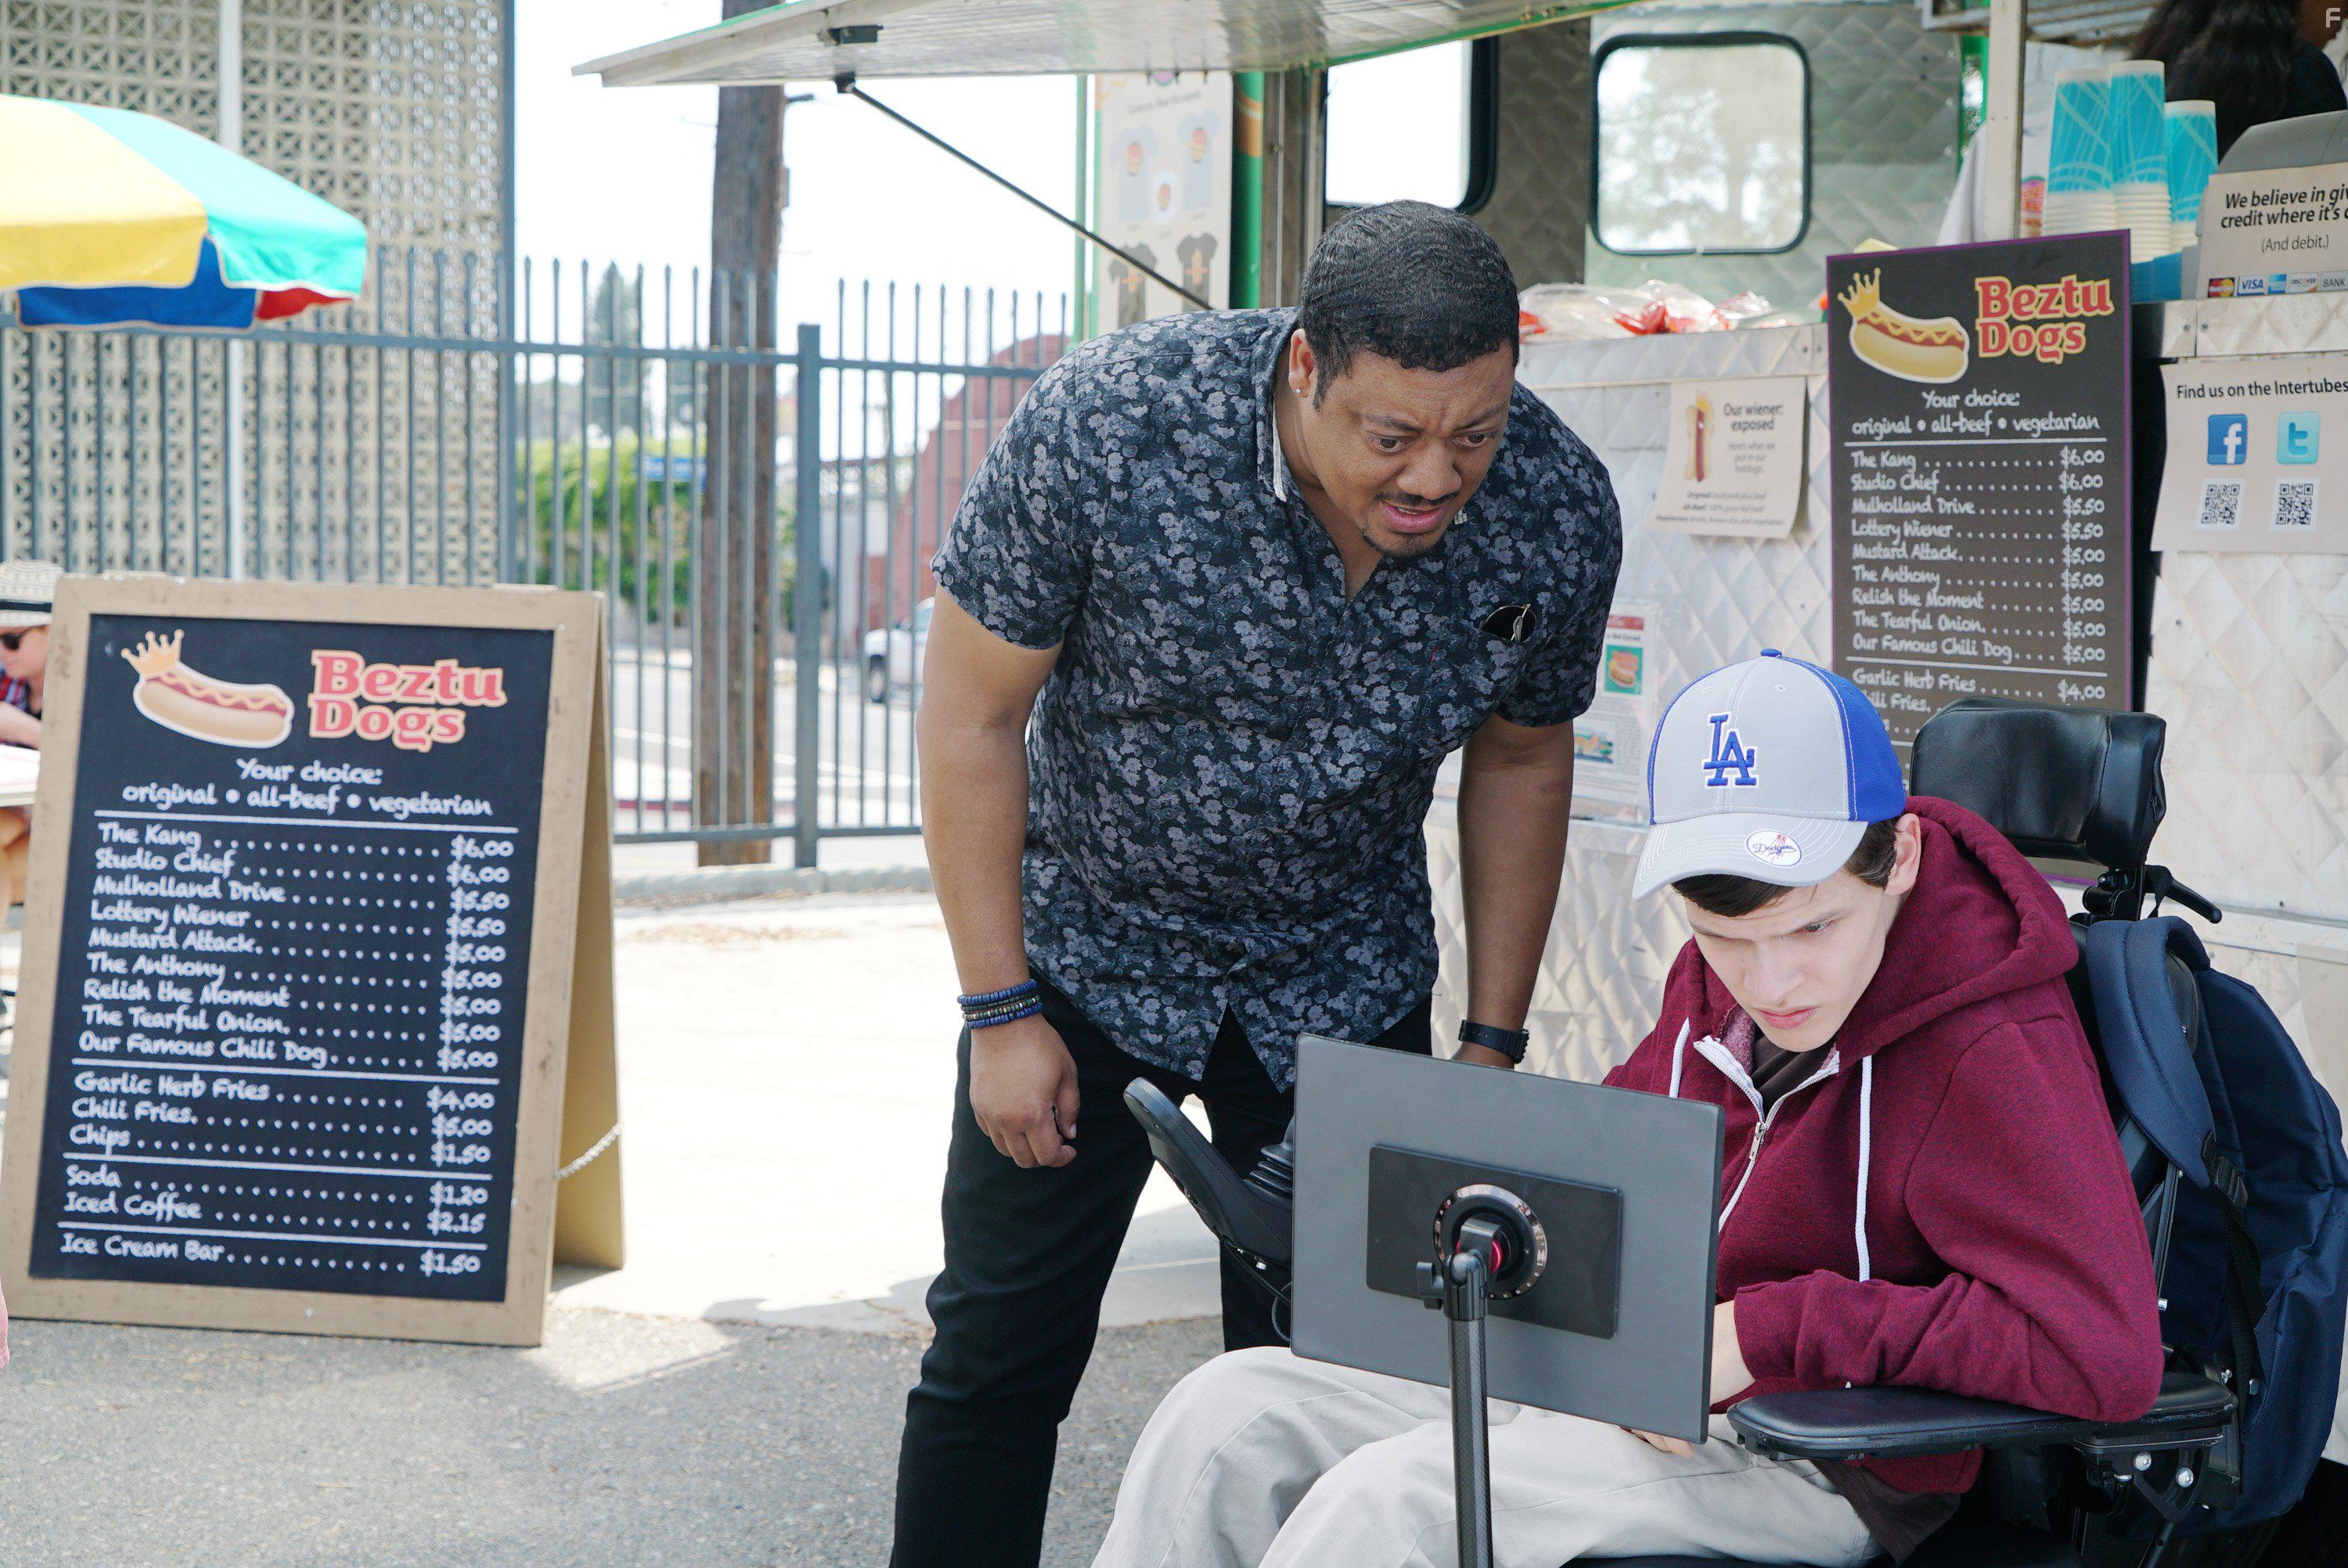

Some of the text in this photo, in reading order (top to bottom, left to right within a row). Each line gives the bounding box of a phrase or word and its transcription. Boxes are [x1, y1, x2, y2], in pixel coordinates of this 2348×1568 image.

[2220, 210, 2263, 228] credit
[2267, 207, 2315, 225] where
[2318, 204, 2340, 221] it's
[2225, 192, 2248, 209] We
[2251, 189, 2307, 207] believe
[2310, 186, 2325, 203] in
[2261, 234, 2329, 254] (And debit.)
[1975, 274, 2115, 321] Beztu
[2242, 278, 2264, 290] VISA
[1975, 318, 2086, 365] Dogs
[1921, 388, 2020, 409] Your choice:
[2177, 378, 2348, 399] Find us on the Intertubes
[1723, 401, 1742, 416] Our
[1730, 416, 1775, 433] exposed
[1852, 408, 2101, 441] original all-beef vegetarian
[1850, 444, 2105, 473] The Kang $6.00
[1850, 469, 2104, 495] Studio Chief $6.00
[1851, 494, 2105, 519] Mulholland Drive $5.50
[1851, 518, 2104, 546] Lottery Wiener $5.50
[1852, 541, 2105, 568] Mustard Attack $5.00
[1852, 563, 2105, 592] The Anthony $5.00
[1852, 587, 2105, 617] Relish the Moment $5.00
[1852, 609, 1878, 628] The
[1881, 608, 1933, 633] Tearful
[2062, 617, 2106, 641] $5.00
[1853, 632, 2106, 666] Our Famous Chili Dog $5.00
[312, 649, 508, 707] Beztu
[1852, 667, 2106, 703] Garlic Herb Fries $4.00
[1890, 692, 1928, 712] Fries
[307, 693, 466, 753] Dogs
[1703, 714, 1756, 786] LA
[236, 757, 383, 785] Your choice:
[122, 782, 494, 820] original all-beef vegetarian
[98, 822, 514, 861] The Kang $6.00
[95, 847, 510, 888] Studio Chief $6.00
[92, 874, 510, 914] Mulholland Drive $5.50
[91, 899, 506, 939] Lottery Wiener $5.50
[88, 926, 506, 966] Mustard Attack $5.00
[86, 951, 502, 991] The Anthony $5.00
[84, 978, 501, 1017] Relish the Moment $5.00
[81, 1003, 501, 1045] The Tearful Onion $5.00
[79, 1030, 499, 1074] Our Famous Chili Dog $5.00
[74, 1070, 495, 1113] Garlic Herb Fries $4.00
[71, 1096, 493, 1139] Chili Fries $5.00
[69, 1122, 492, 1167] Chips $1.50
[66, 1163, 489, 1207] Soda $1.20
[63, 1190, 488, 1236] Iced Coffee $2.15
[60, 1232, 481, 1278] Ice Cream Bar $1.50
